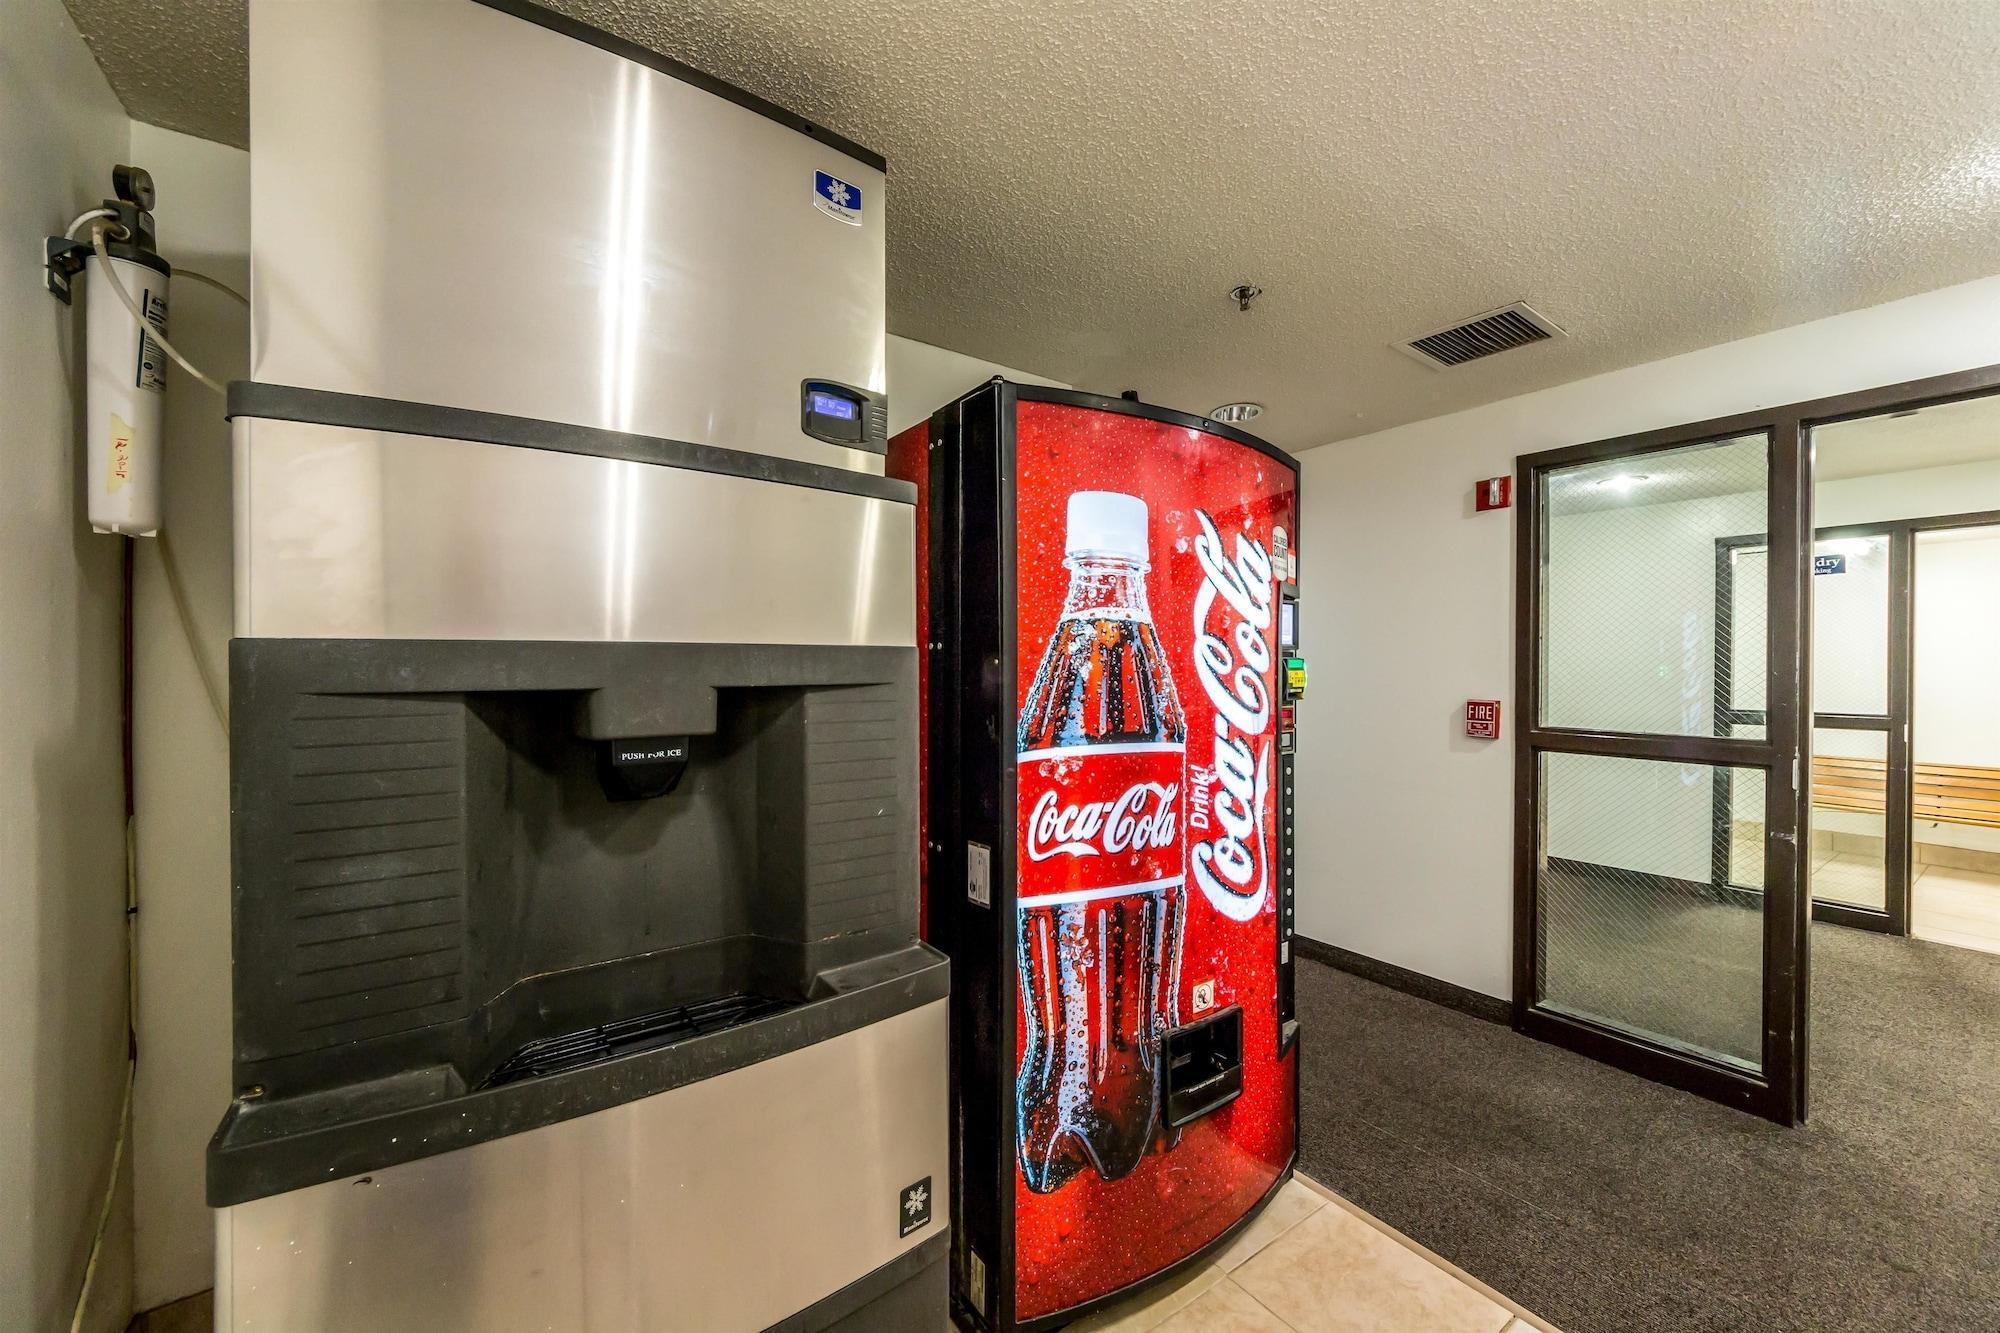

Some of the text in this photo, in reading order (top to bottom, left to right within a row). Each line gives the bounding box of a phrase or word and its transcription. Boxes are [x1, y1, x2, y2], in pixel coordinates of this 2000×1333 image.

[1193, 508, 1273, 922] Coca-Cola
[1468, 705, 1492, 719] FIRE
[622, 752, 644, 760] PUSH
[1028, 783, 1178, 861] Coca-Cola
